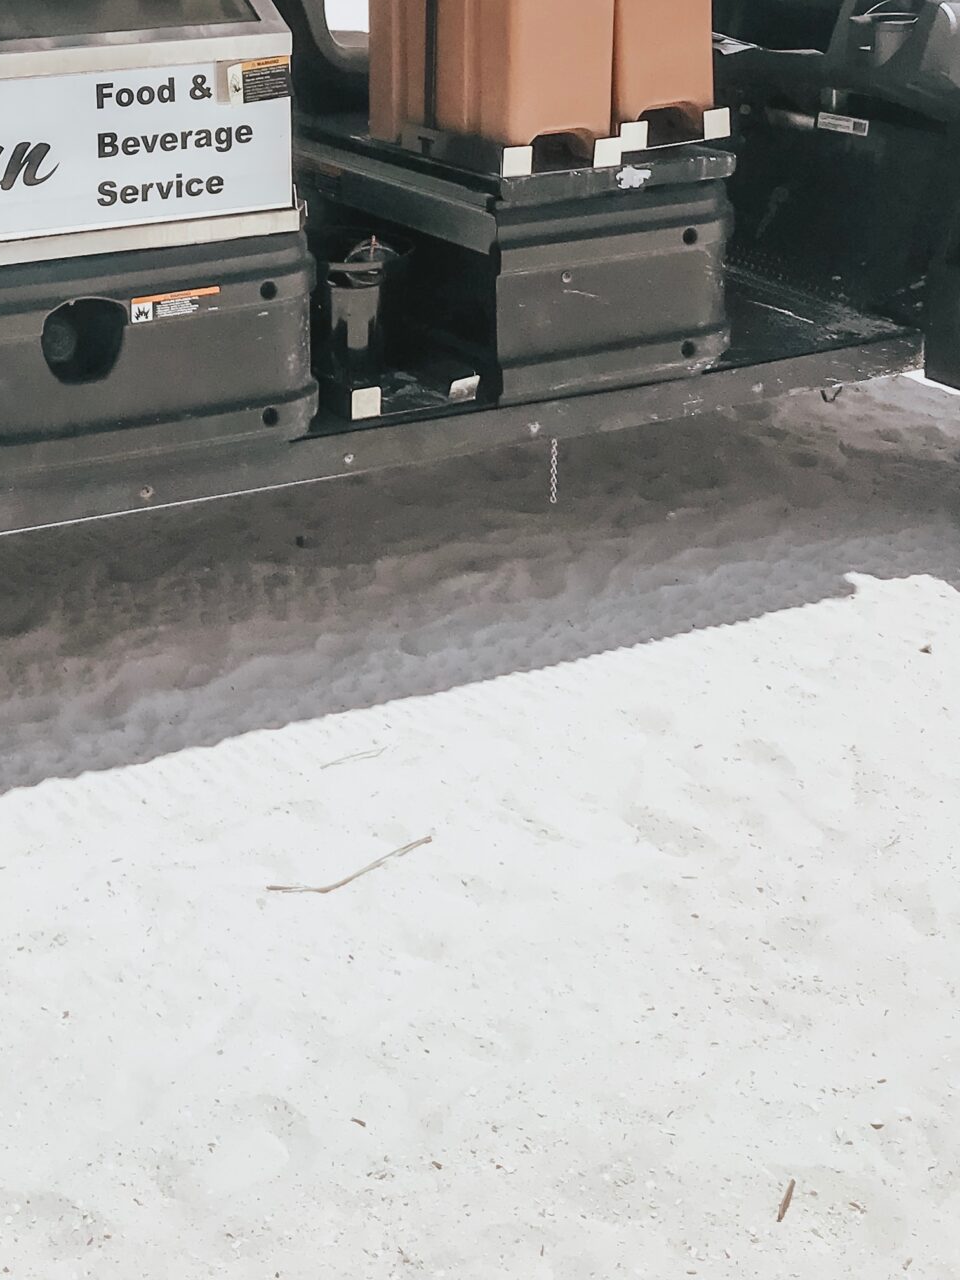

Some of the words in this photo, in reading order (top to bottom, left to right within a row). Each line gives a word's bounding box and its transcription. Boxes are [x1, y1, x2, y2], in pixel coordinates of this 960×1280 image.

[95, 77, 176, 110] Food
[189, 74, 213, 101] &
[97, 124, 254, 159] Beverage
[97, 173, 225, 207] Service
